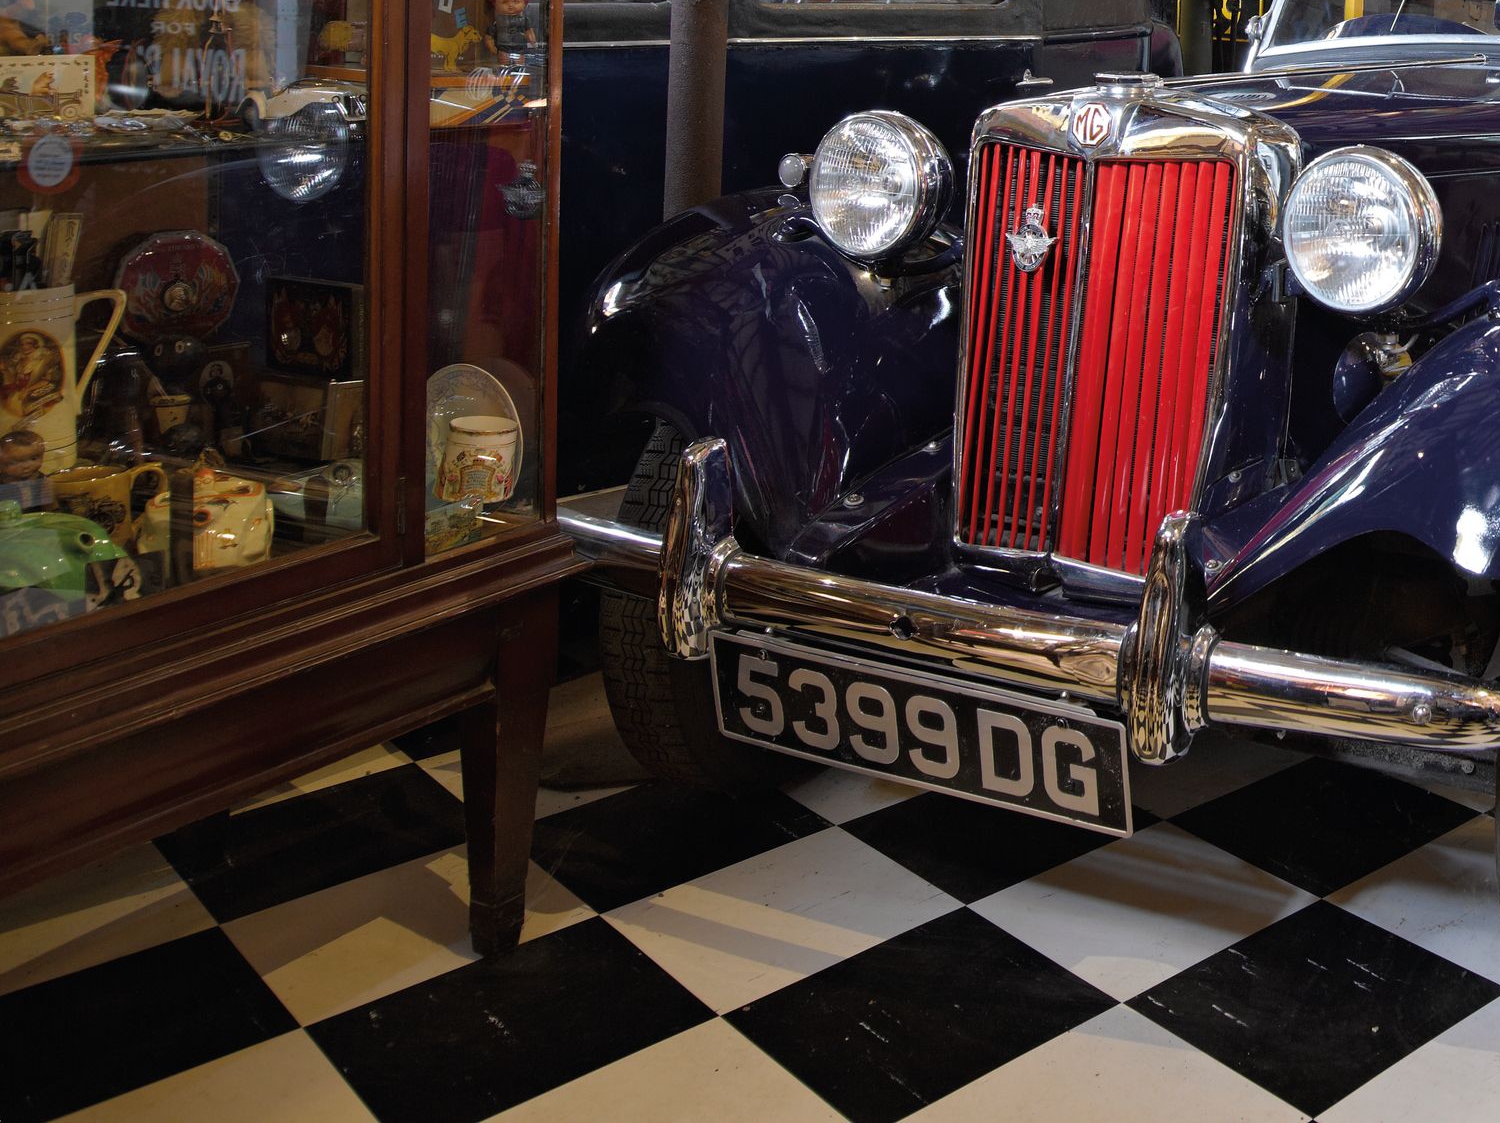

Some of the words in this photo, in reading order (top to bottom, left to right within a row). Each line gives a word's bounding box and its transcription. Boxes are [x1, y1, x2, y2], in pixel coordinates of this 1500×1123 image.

[1074, 106, 1111, 142] MG
[737, 656, 961, 780] 5399
[978, 708, 1100, 816] DG
